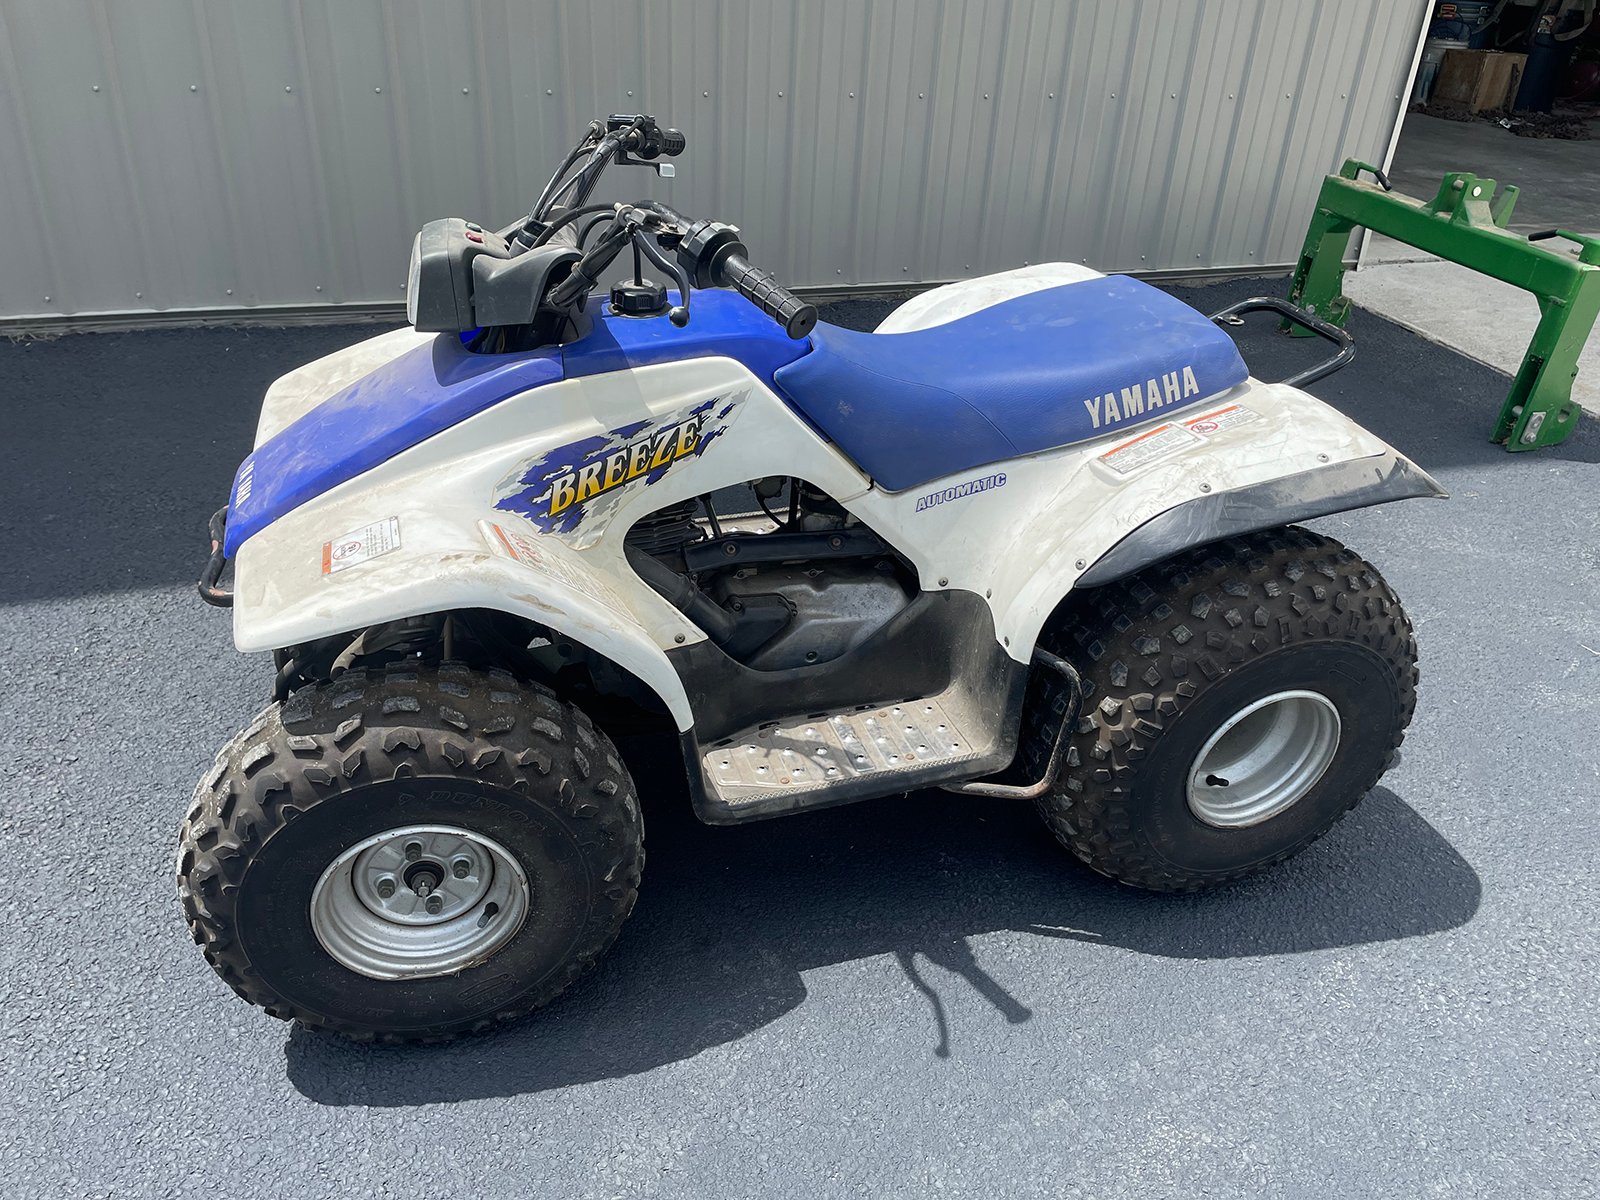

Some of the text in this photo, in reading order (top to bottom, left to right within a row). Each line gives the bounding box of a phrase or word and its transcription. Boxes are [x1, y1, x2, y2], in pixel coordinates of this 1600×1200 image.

[1083, 365, 1200, 429] YAMAHA
[548, 414, 701, 517] BREEZE
[915, 472, 1007, 512] AUTOMATIC
